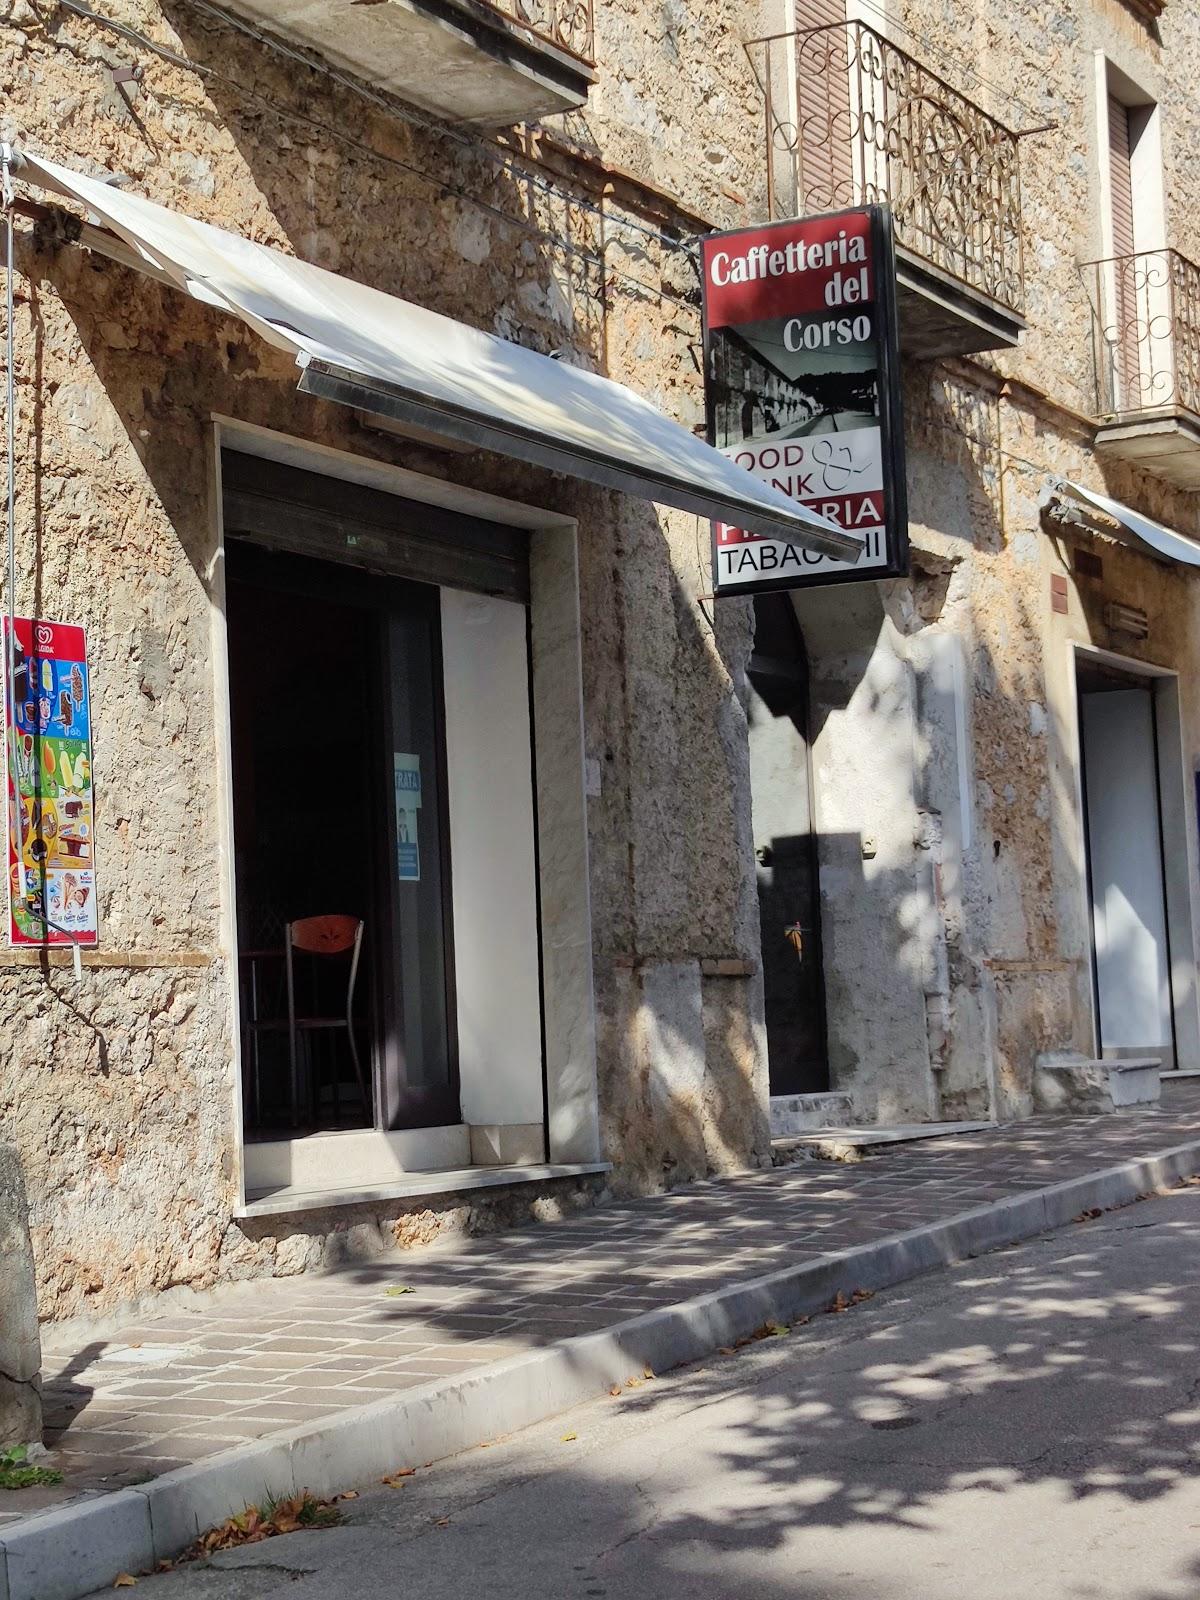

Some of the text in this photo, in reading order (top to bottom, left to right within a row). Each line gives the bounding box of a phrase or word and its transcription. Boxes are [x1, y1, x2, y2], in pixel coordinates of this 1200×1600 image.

[710, 230, 868, 287] Caffetteria
[824, 267, 870, 307] del
[783, 314, 871, 353] Corso
[725, 445, 804, 472] OOD
[720, 532, 880, 574] TABACI
[396, 771, 419, 789] RATA
